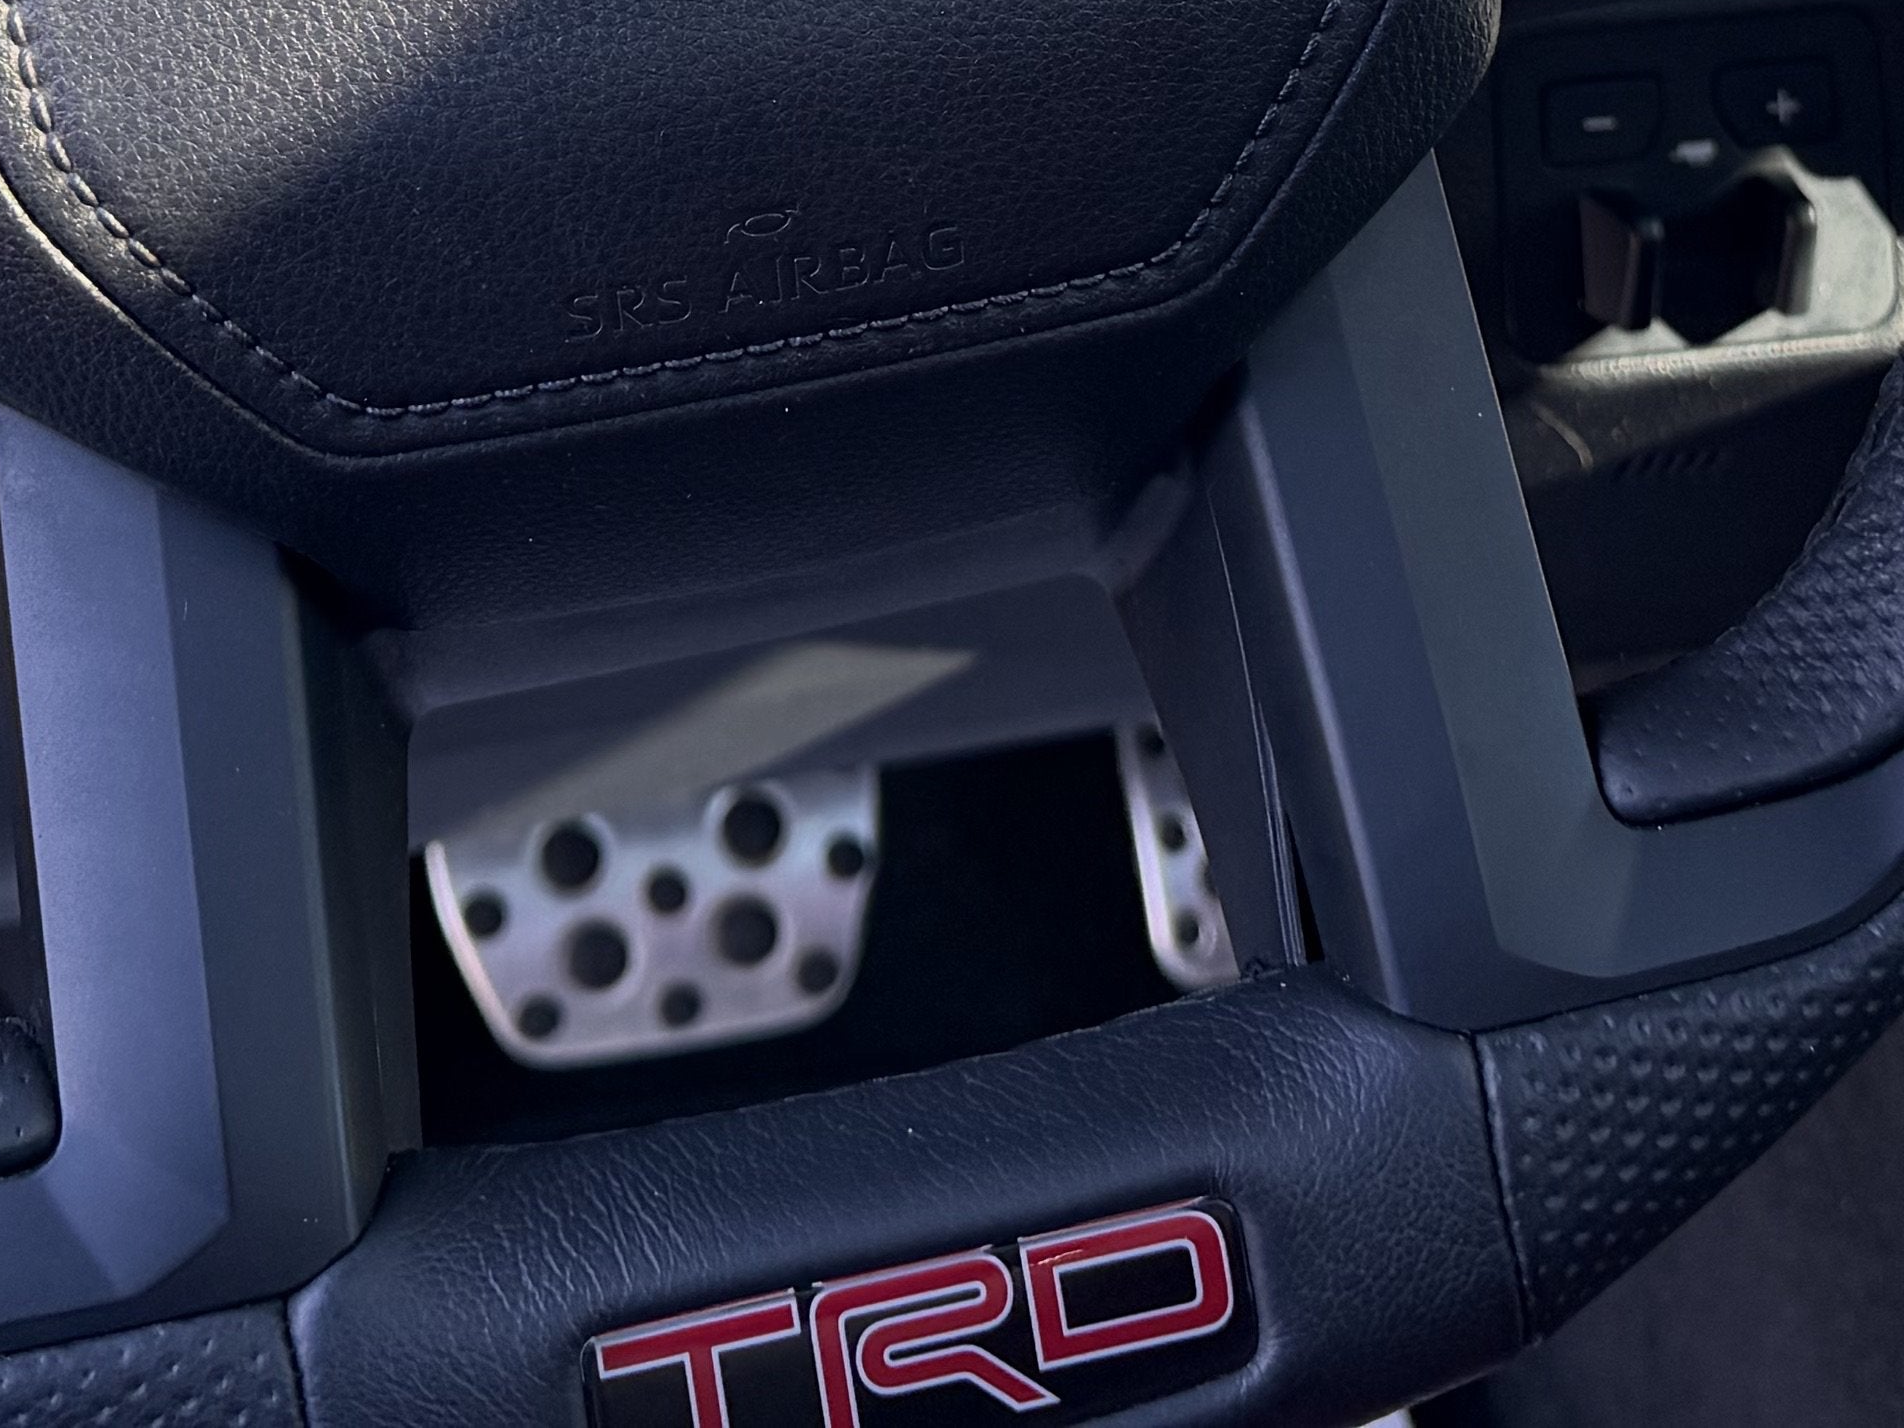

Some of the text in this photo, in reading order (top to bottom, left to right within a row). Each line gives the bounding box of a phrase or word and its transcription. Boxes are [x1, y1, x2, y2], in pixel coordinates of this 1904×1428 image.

[566, 225, 966, 341] SRS AIRBAG
[591, 1198, 1235, 1428] TRD
